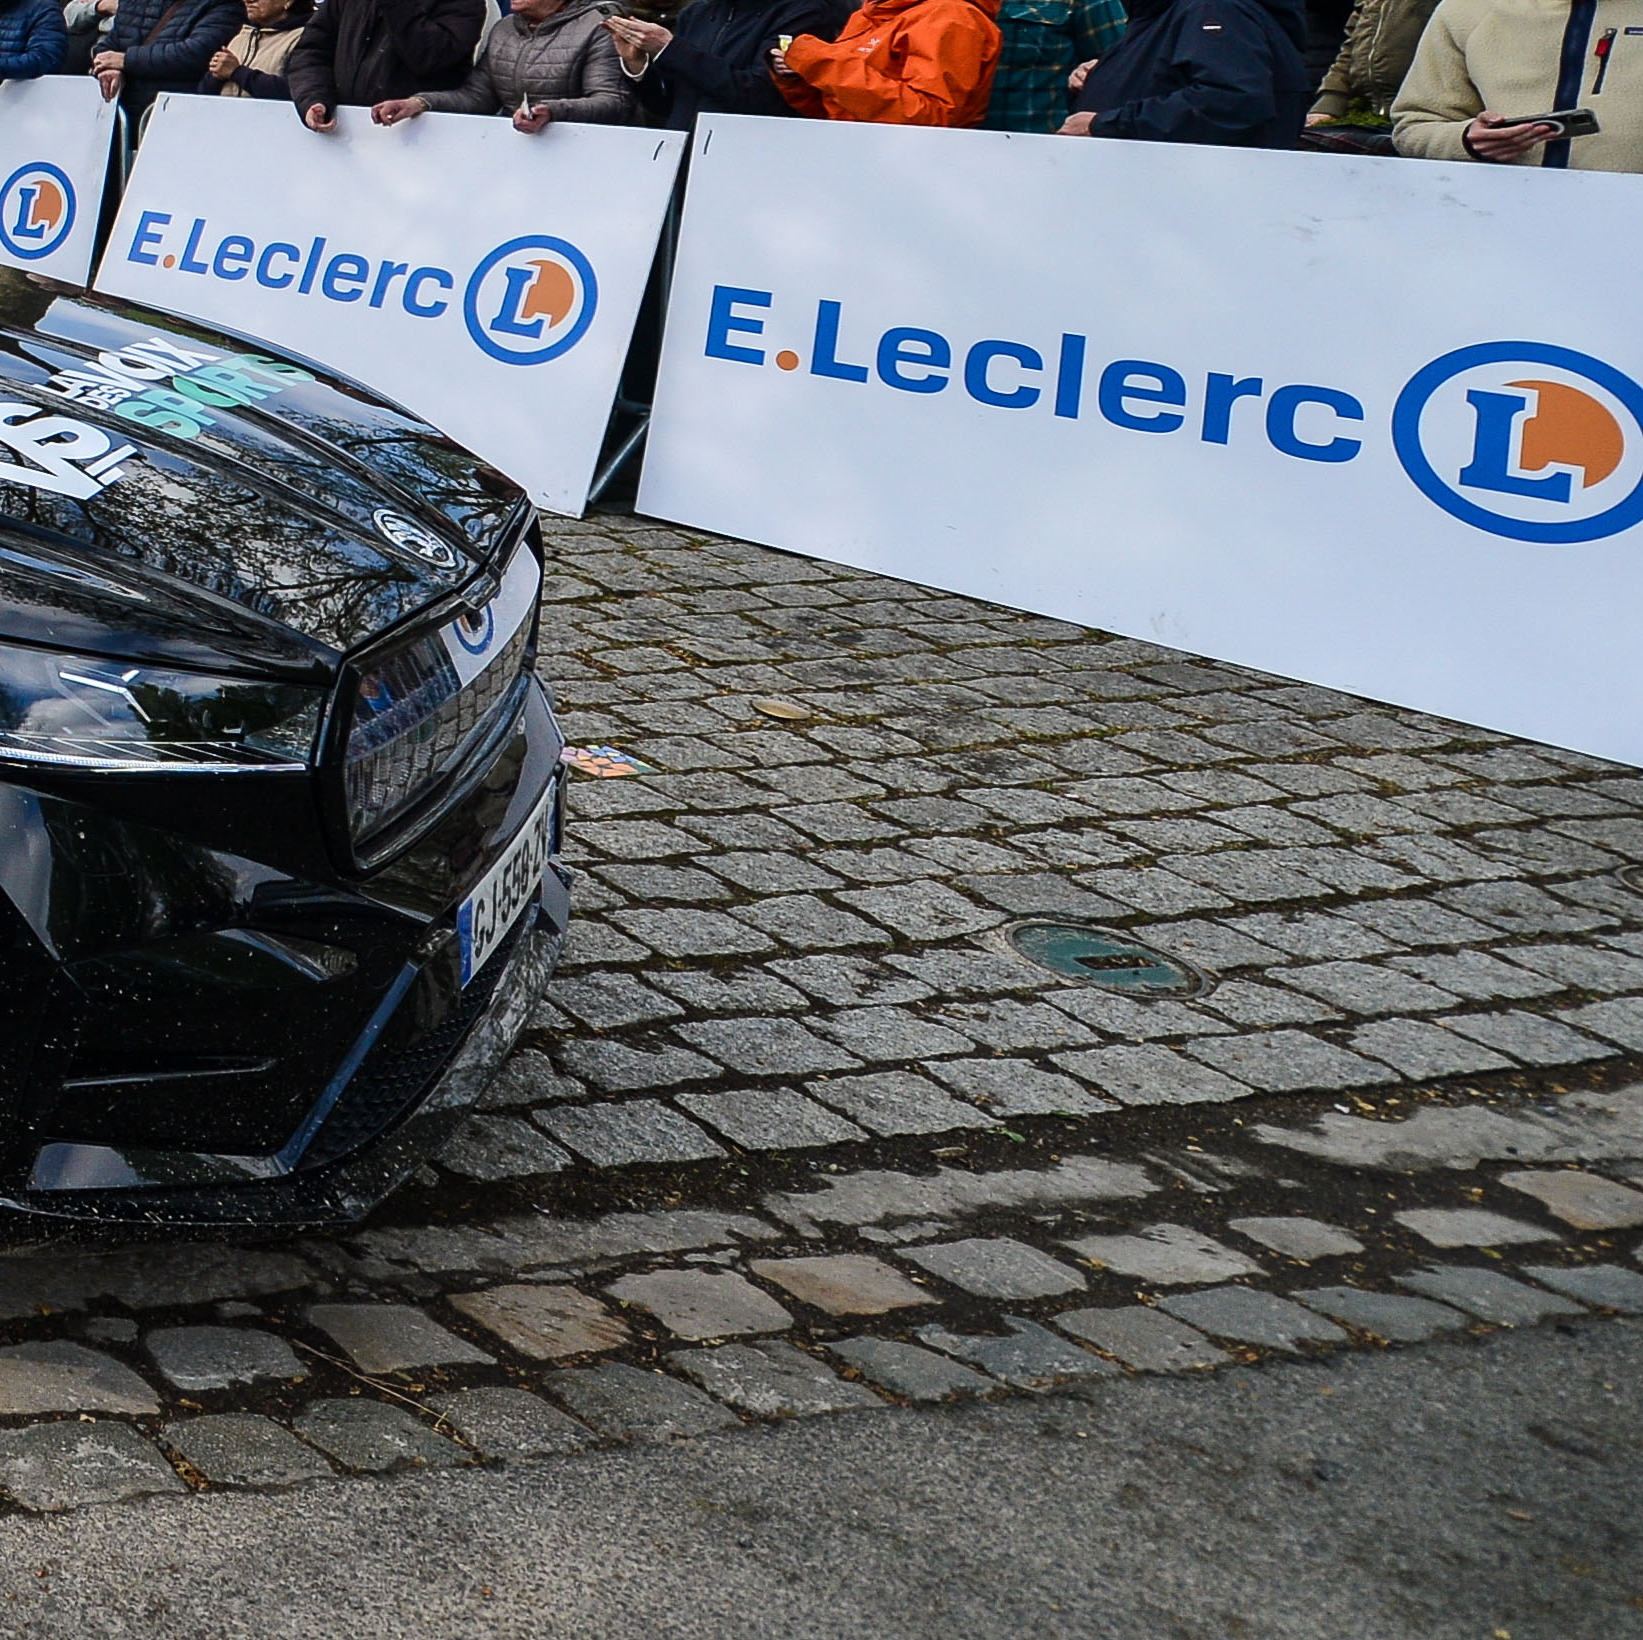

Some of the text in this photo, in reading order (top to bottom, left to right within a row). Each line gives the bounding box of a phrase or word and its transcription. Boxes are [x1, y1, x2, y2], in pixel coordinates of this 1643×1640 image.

[127, 210, 454, 320] E.Leclerc
[32, 337, 221, 399] LA VOIX
[74, 384, 134, 411] DES
[115, 353, 316, 439] SPORTS
[704, 283, 1366, 465] E.Leclerc
